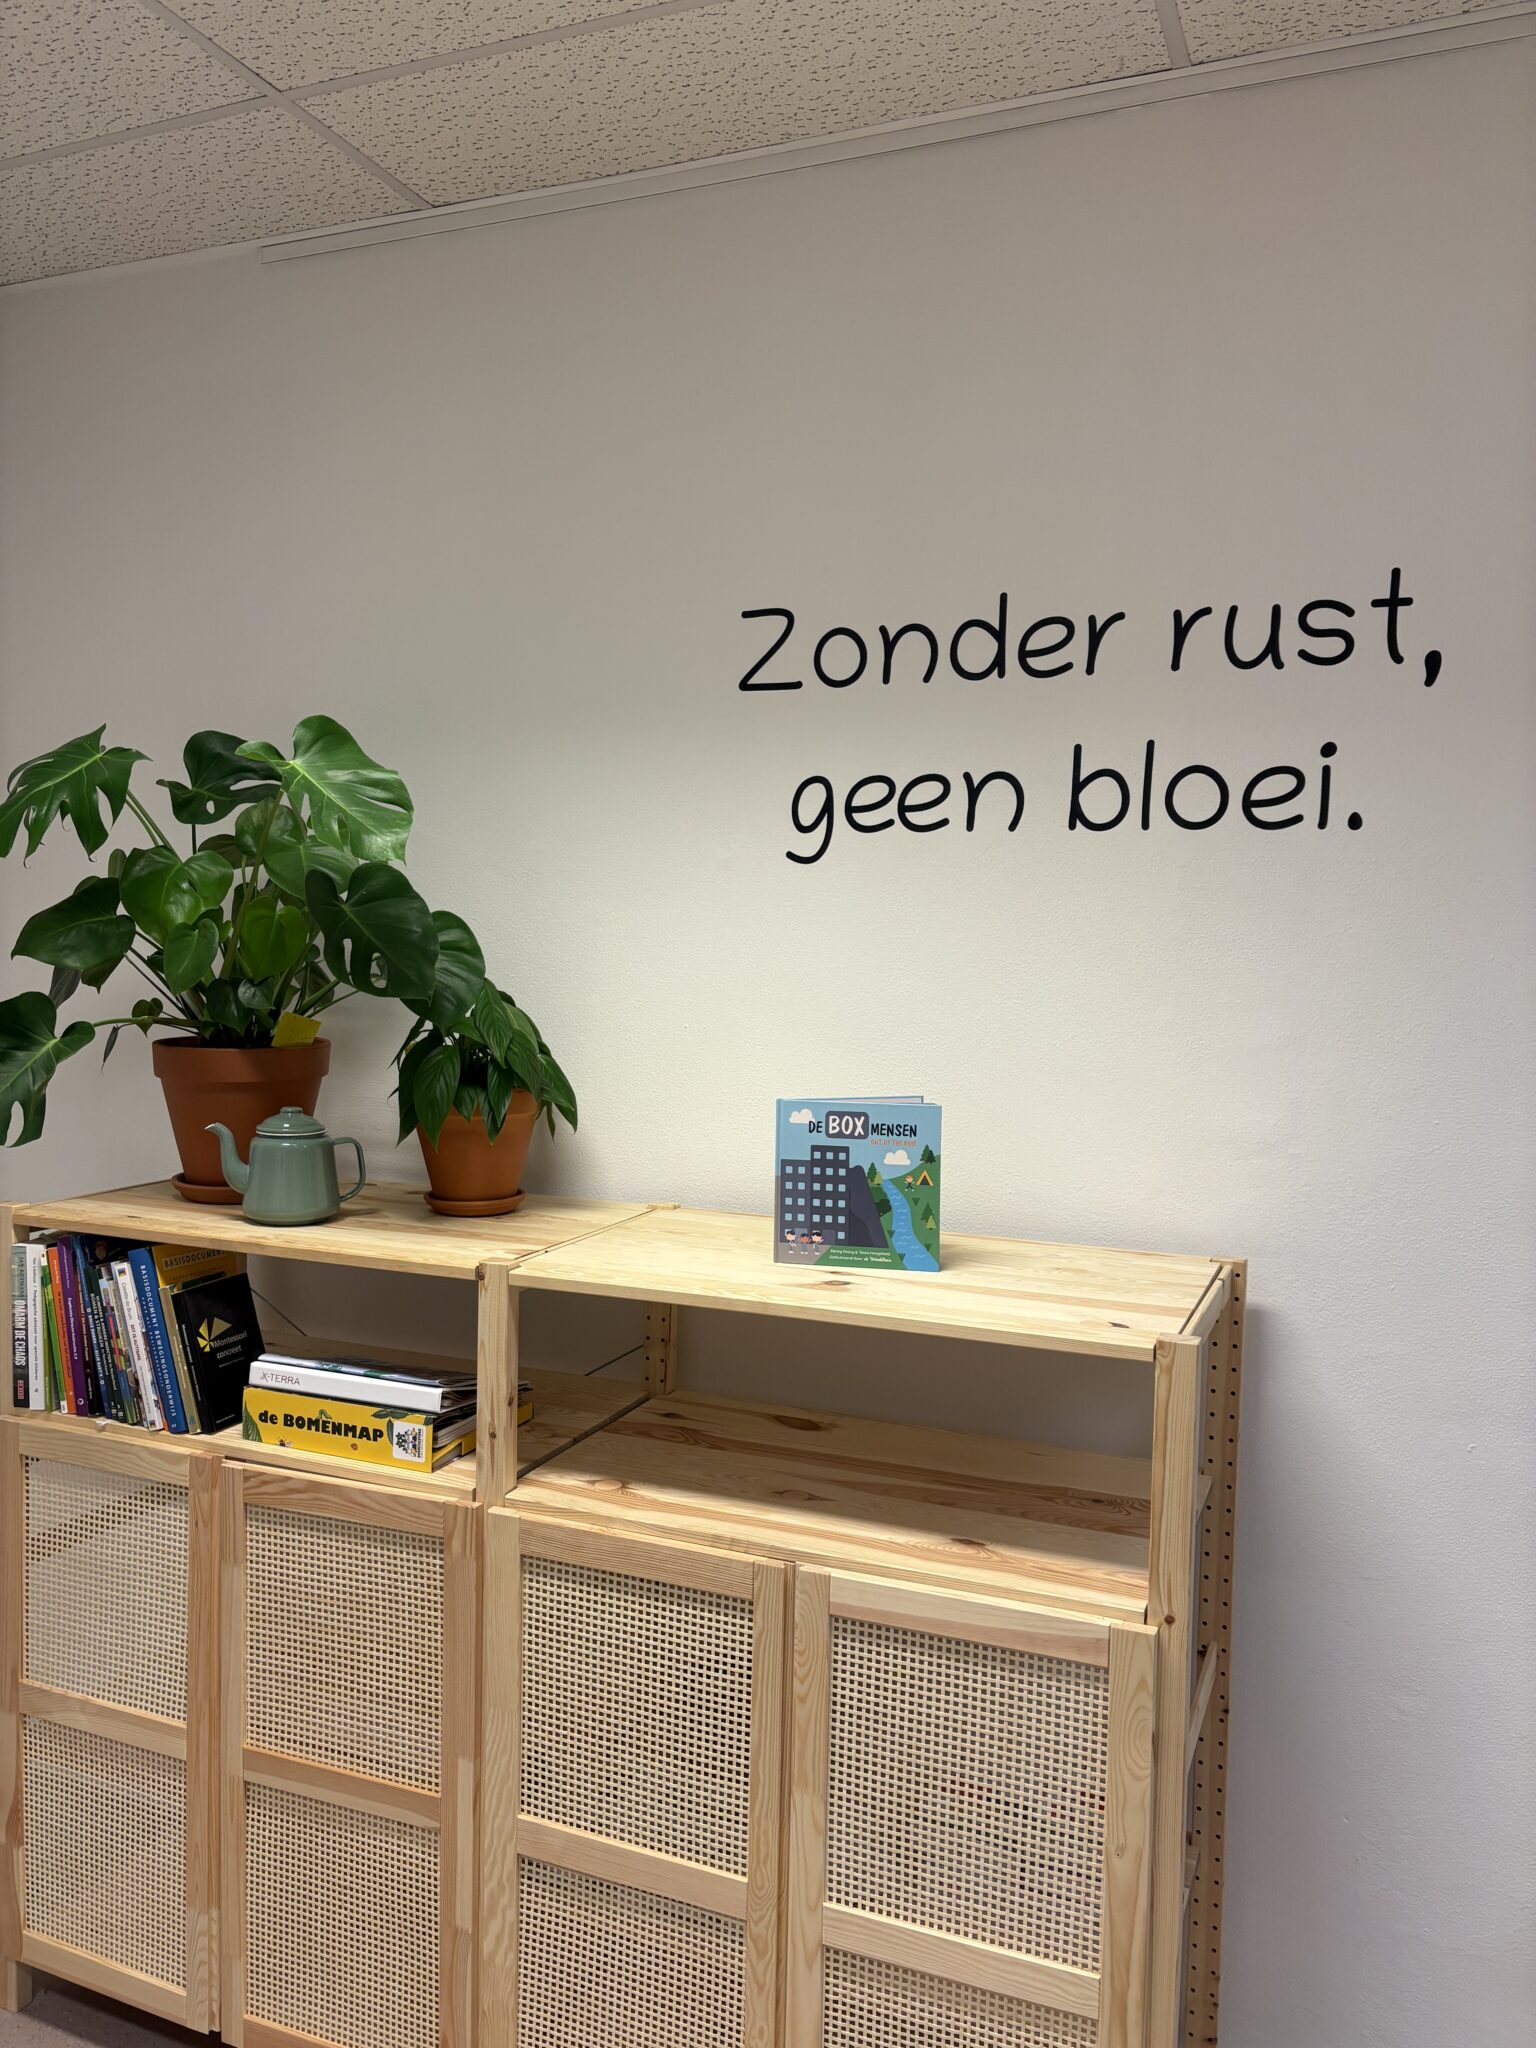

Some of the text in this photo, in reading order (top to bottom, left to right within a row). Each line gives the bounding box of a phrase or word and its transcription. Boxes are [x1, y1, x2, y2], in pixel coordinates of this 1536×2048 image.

[738, 567, 1443, 691] Zonder rust,
[786, 740, 1363, 864] geen bloei.
[808, 1115, 917, 1137] DE BOX MENSEN
[164, 1250, 225, 1269] BASISDOCUMENT
[14, 1300, 25, 1329] OMARM
[121, 1281, 134, 1321] Colette de Bruin
[89, 1293, 98, 1314] BOMEN
[95, 1319, 104, 1348] STRUIKEN
[95, 1295, 104, 1319] VLINDERS
[104, 1340, 112, 1364] INSECTEN
[14, 1330, 25, 1340] DE
[140, 1264, 177, 1417] BASISDOCUMENT BEWEGINGSONDERWIJS
[213, 1330, 248, 1348] Montessori
[15, 1340, 26, 1366] CHAOS
[132, 1338, 142, 1362] AUTISME
[216, 1344, 242, 1359] concreet
[259, 1371, 300, 1386] X-TERRA
[258, 1410, 278, 1424] de
[284, 1413, 384, 1442] BOMENMAP
